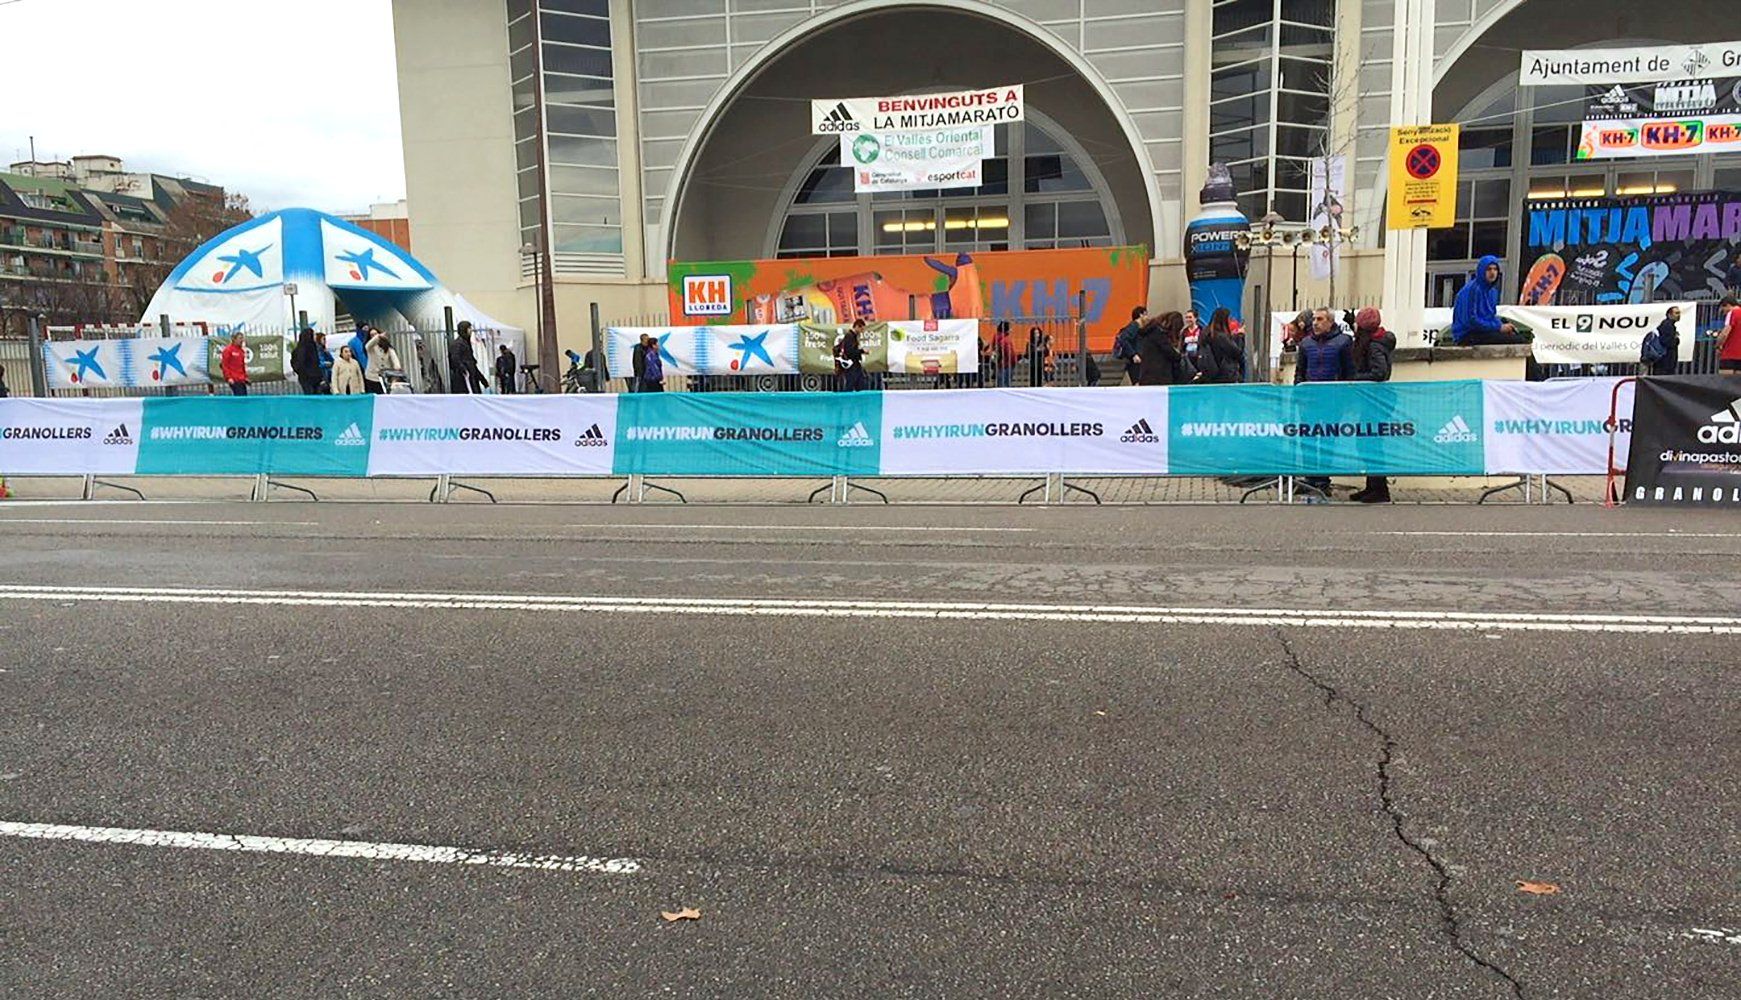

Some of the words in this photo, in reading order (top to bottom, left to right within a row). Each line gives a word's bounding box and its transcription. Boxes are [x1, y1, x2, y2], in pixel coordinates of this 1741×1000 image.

[1530, 56, 1639, 78] Ajuntament
[1648, 56, 1670, 71] de
[878, 91, 998, 112] BENVINGUTS
[1005, 89, 1018, 102] A
[874, 115, 894, 129] LA
[900, 104, 1019, 128] MITJAMARATÓ
[819, 120, 860, 132] adidas
[936, 130, 983, 144] Oriental
[928, 170, 975, 182] esportcat
[689, 280, 726, 303] KH
[1551, 317, 1570, 329] EL
[1577, 315, 1592, 331] 9
[1599, 316, 1648, 329] NOU
[906, 333, 926, 342] Food
[1582, 341, 1597, 351] del
[0, 426, 92, 440] GRANOLLERS
[1120, 432, 1160, 444] adidas
[1433, 431, 1478, 444] adidas
[103, 435, 133, 446] adidas
[335, 436, 366, 446] adidas
[574, 437, 608, 447] adidas
[837, 437, 874, 447] adidas
